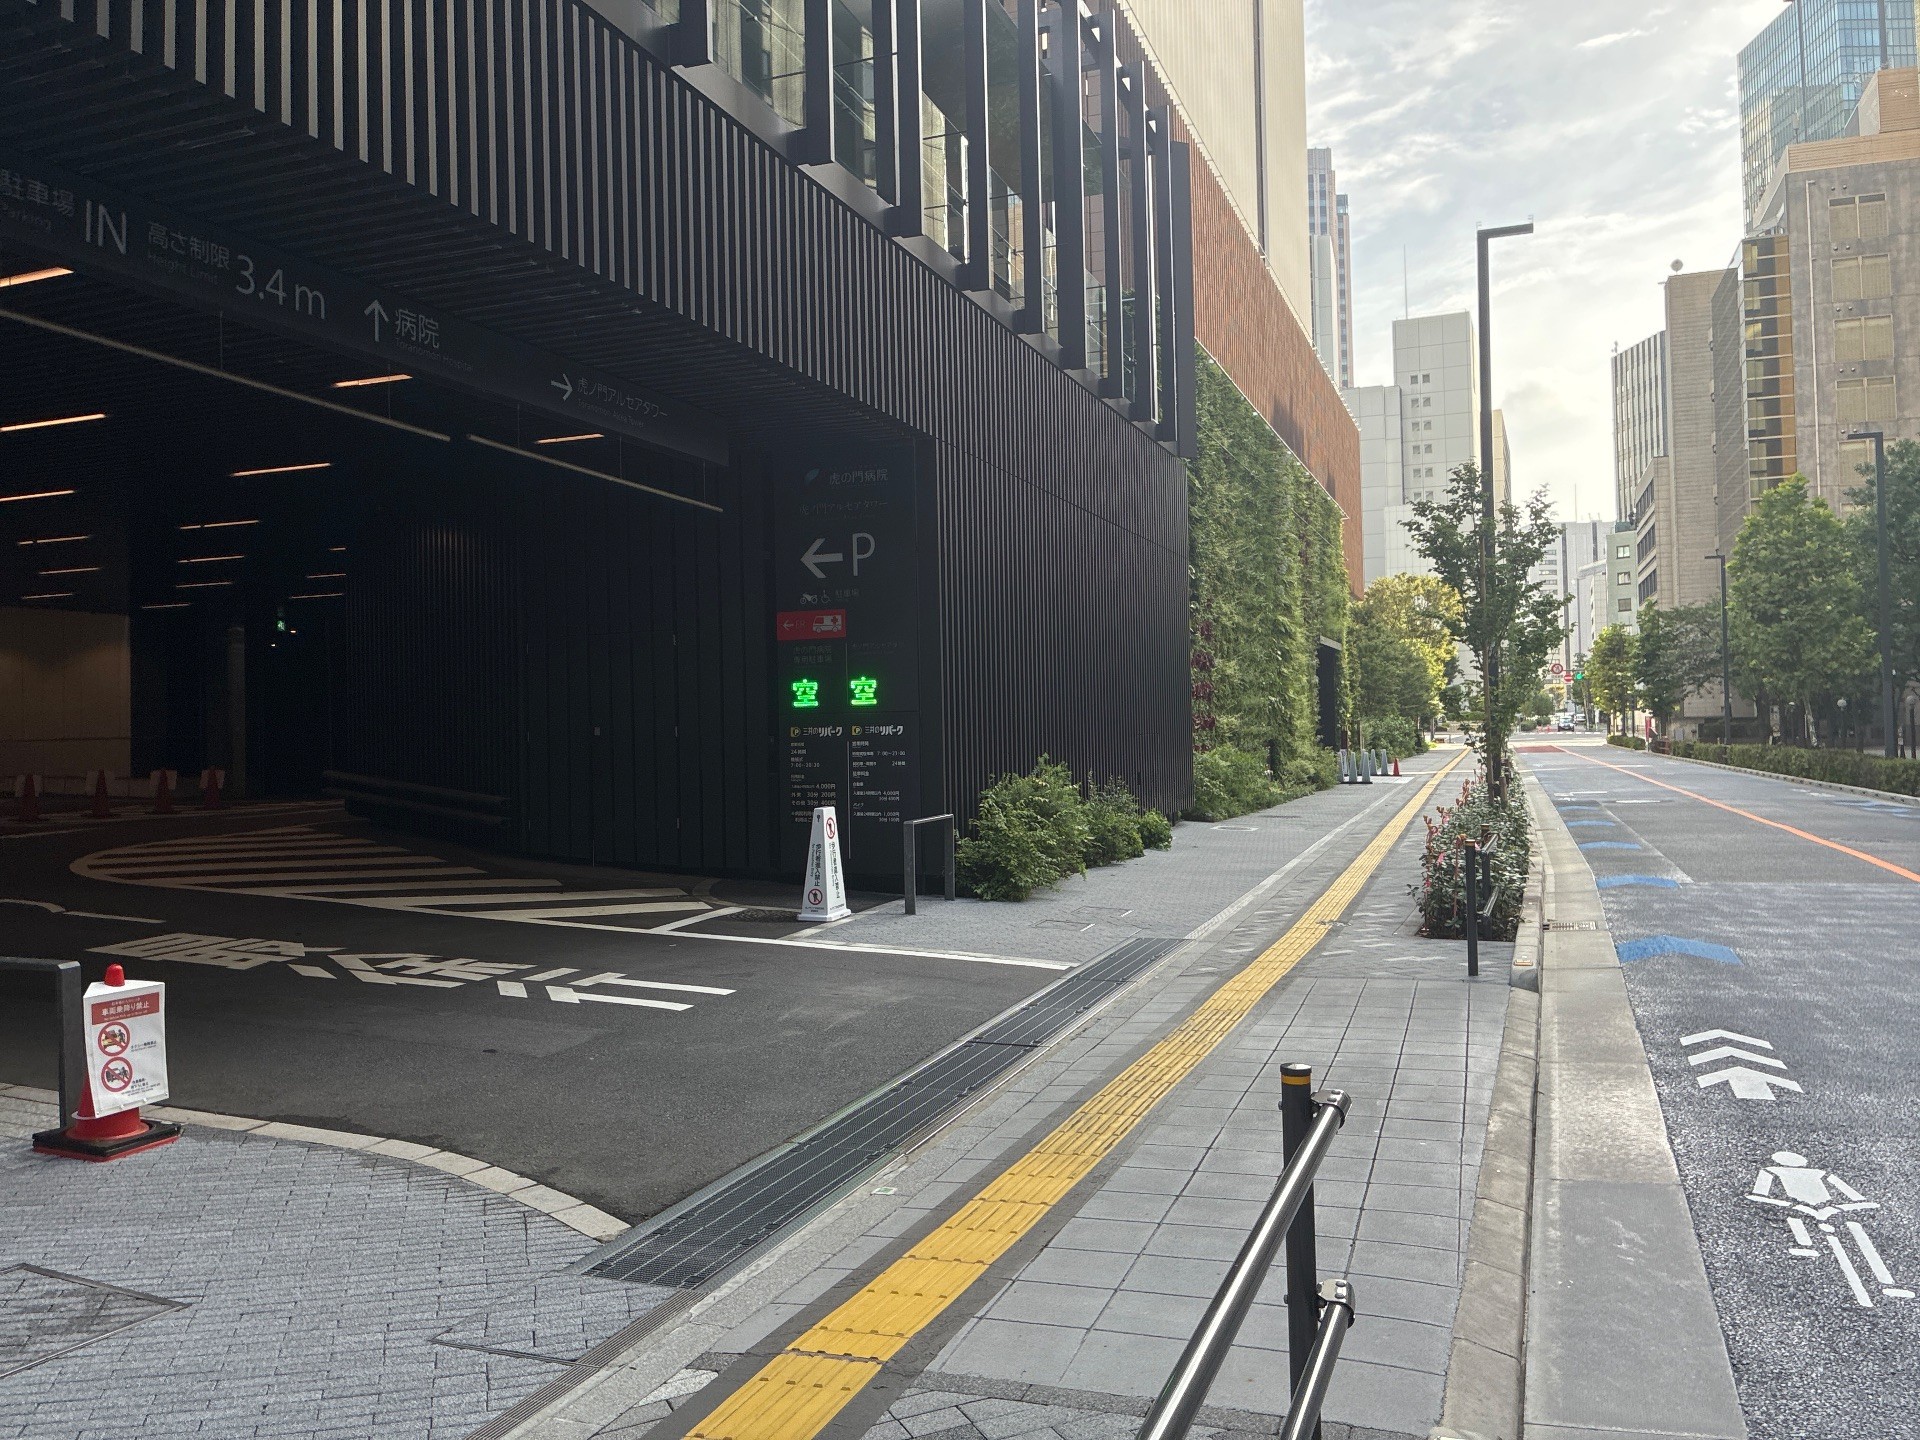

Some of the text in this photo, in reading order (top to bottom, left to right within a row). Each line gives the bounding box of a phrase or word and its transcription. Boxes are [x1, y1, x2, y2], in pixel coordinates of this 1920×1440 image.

[85, 199, 128, 255] IN
[147, 221, 230, 271] 高さ制限
[395, 309, 440, 350] 病院
[828, 469, 889, 485] 虎の門病院
[852, 532, 876, 576] P
[792, 678, 819, 709] 空
[850, 676, 878, 706] 空
[86, 933, 737, 1011] 最徐行
[101, 1000, 150, 1016] 車両乗降り禁止
